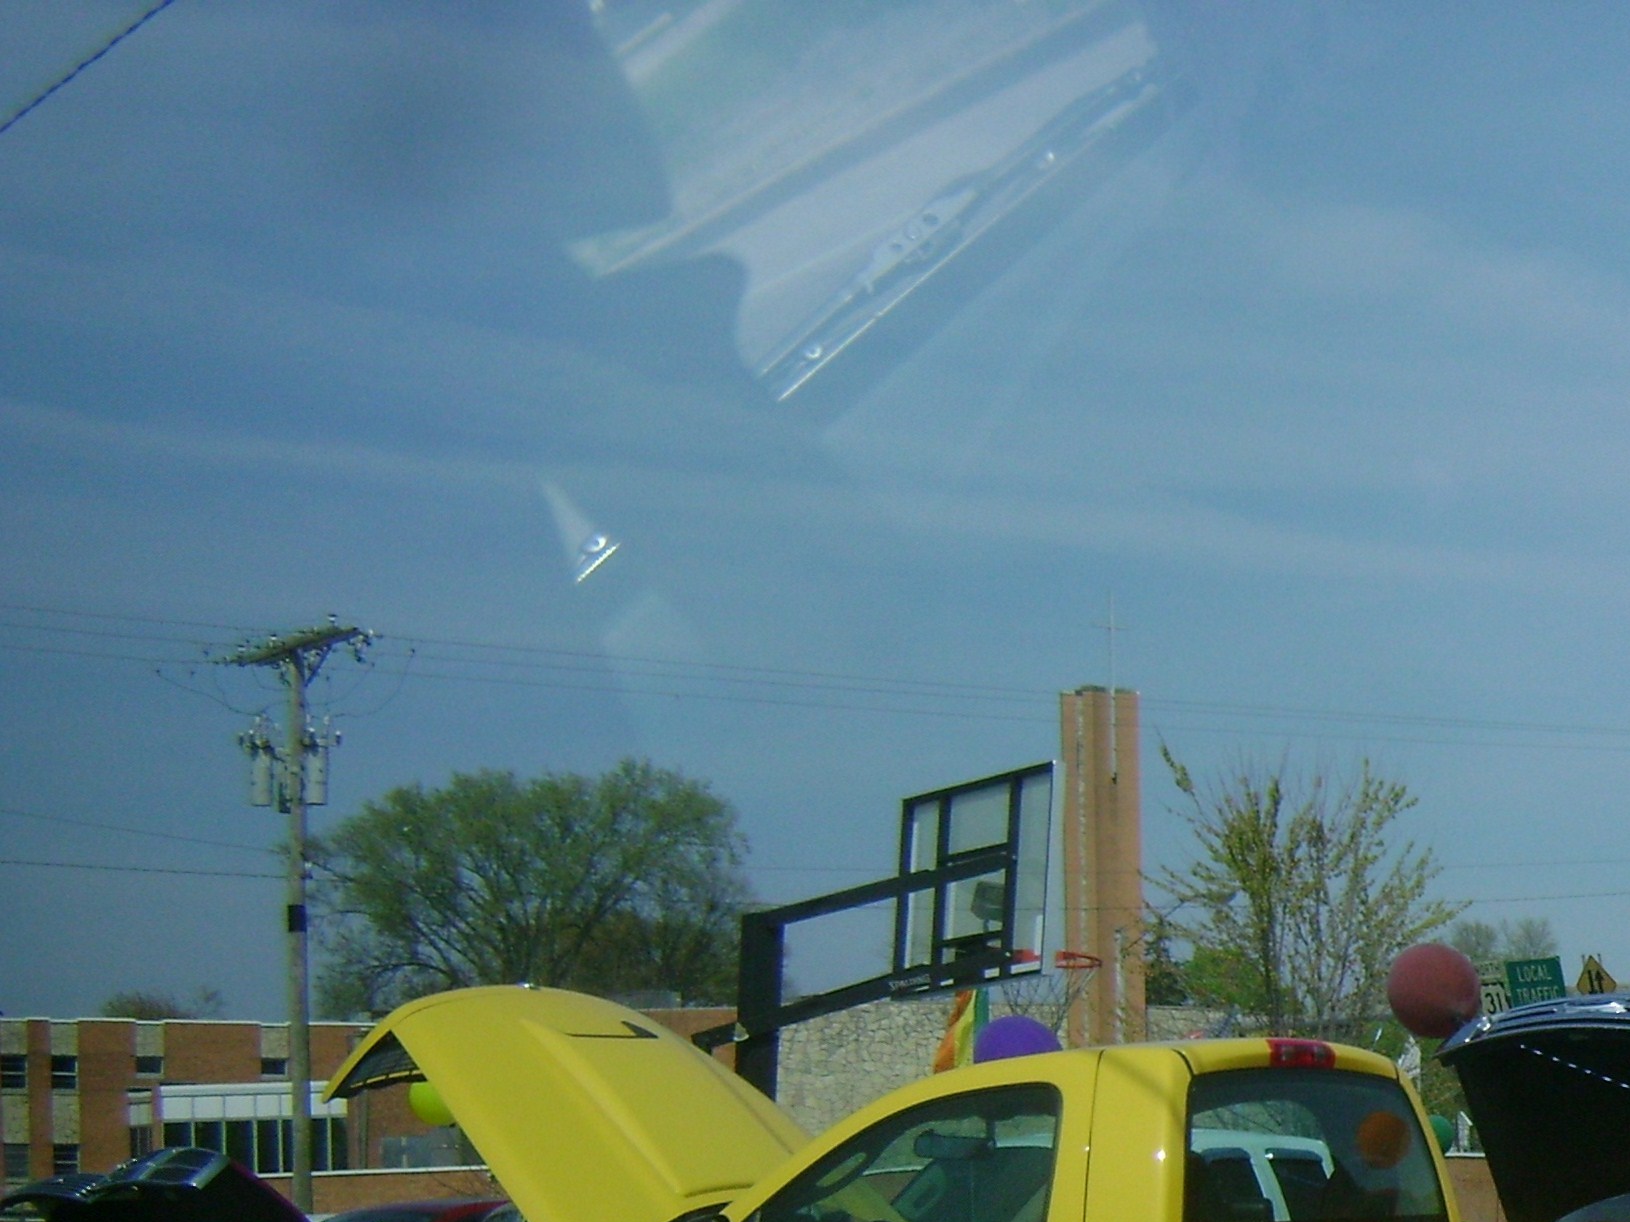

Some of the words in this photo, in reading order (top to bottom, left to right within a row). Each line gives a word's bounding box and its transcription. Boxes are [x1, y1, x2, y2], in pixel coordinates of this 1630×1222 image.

[1516, 964, 1552, 982] LOCAL
[1484, 992, 1504, 1014] 31
[1516, 986, 1559, 1007] TRAFFIC
